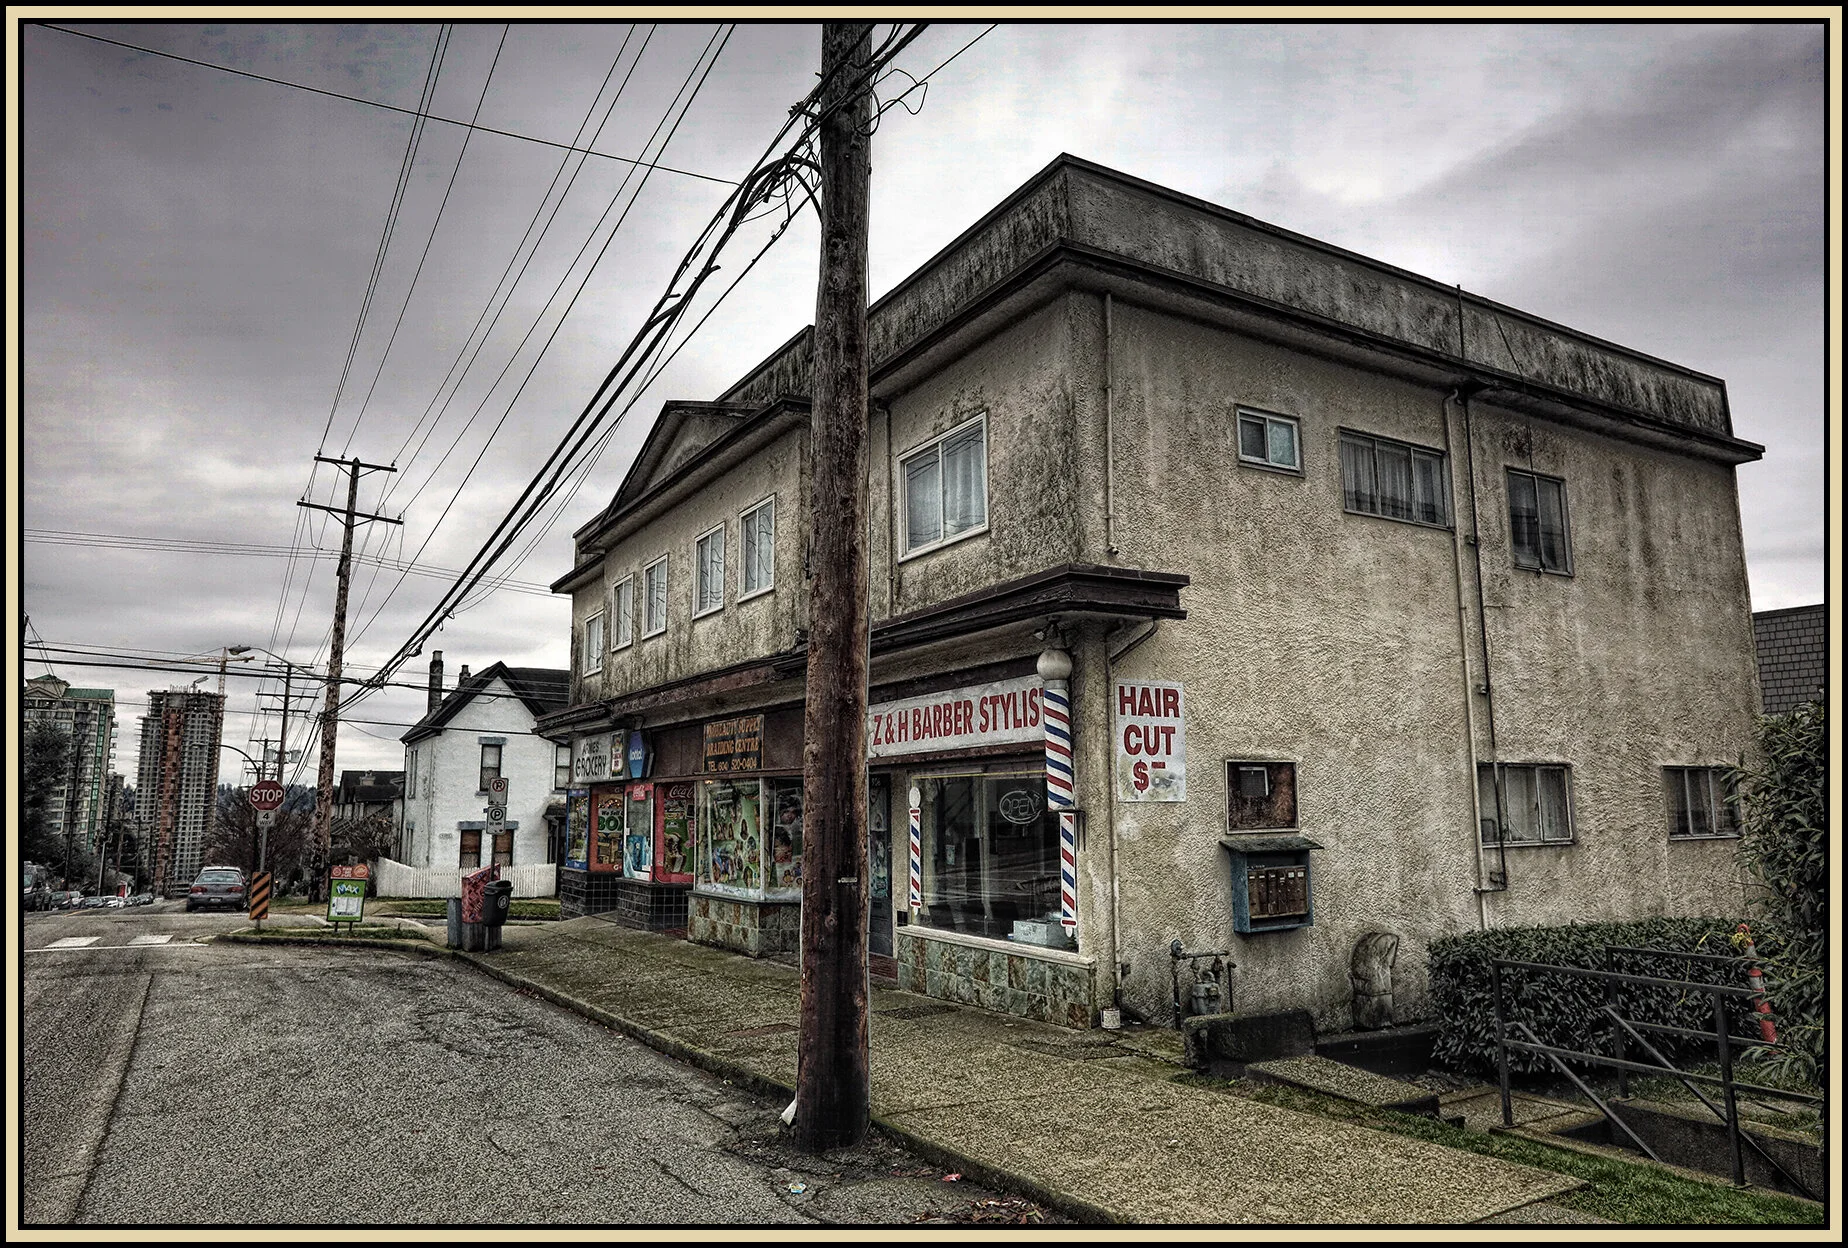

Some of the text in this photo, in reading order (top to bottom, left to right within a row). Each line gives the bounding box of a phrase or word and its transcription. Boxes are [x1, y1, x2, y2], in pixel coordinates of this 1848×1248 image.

[1119, 686, 1180, 718] HAIR
[873, 688, 1044, 746] Z & H BARBER STYLIS
[1123, 724, 1176, 755] CUT
[575, 754, 607, 778] GROCERY
[251, 788, 283, 802] STOP
[1002, 794, 1039, 816] OPEN
[262, 812, 270, 820] 4
[336, 883, 359, 895] MAX
